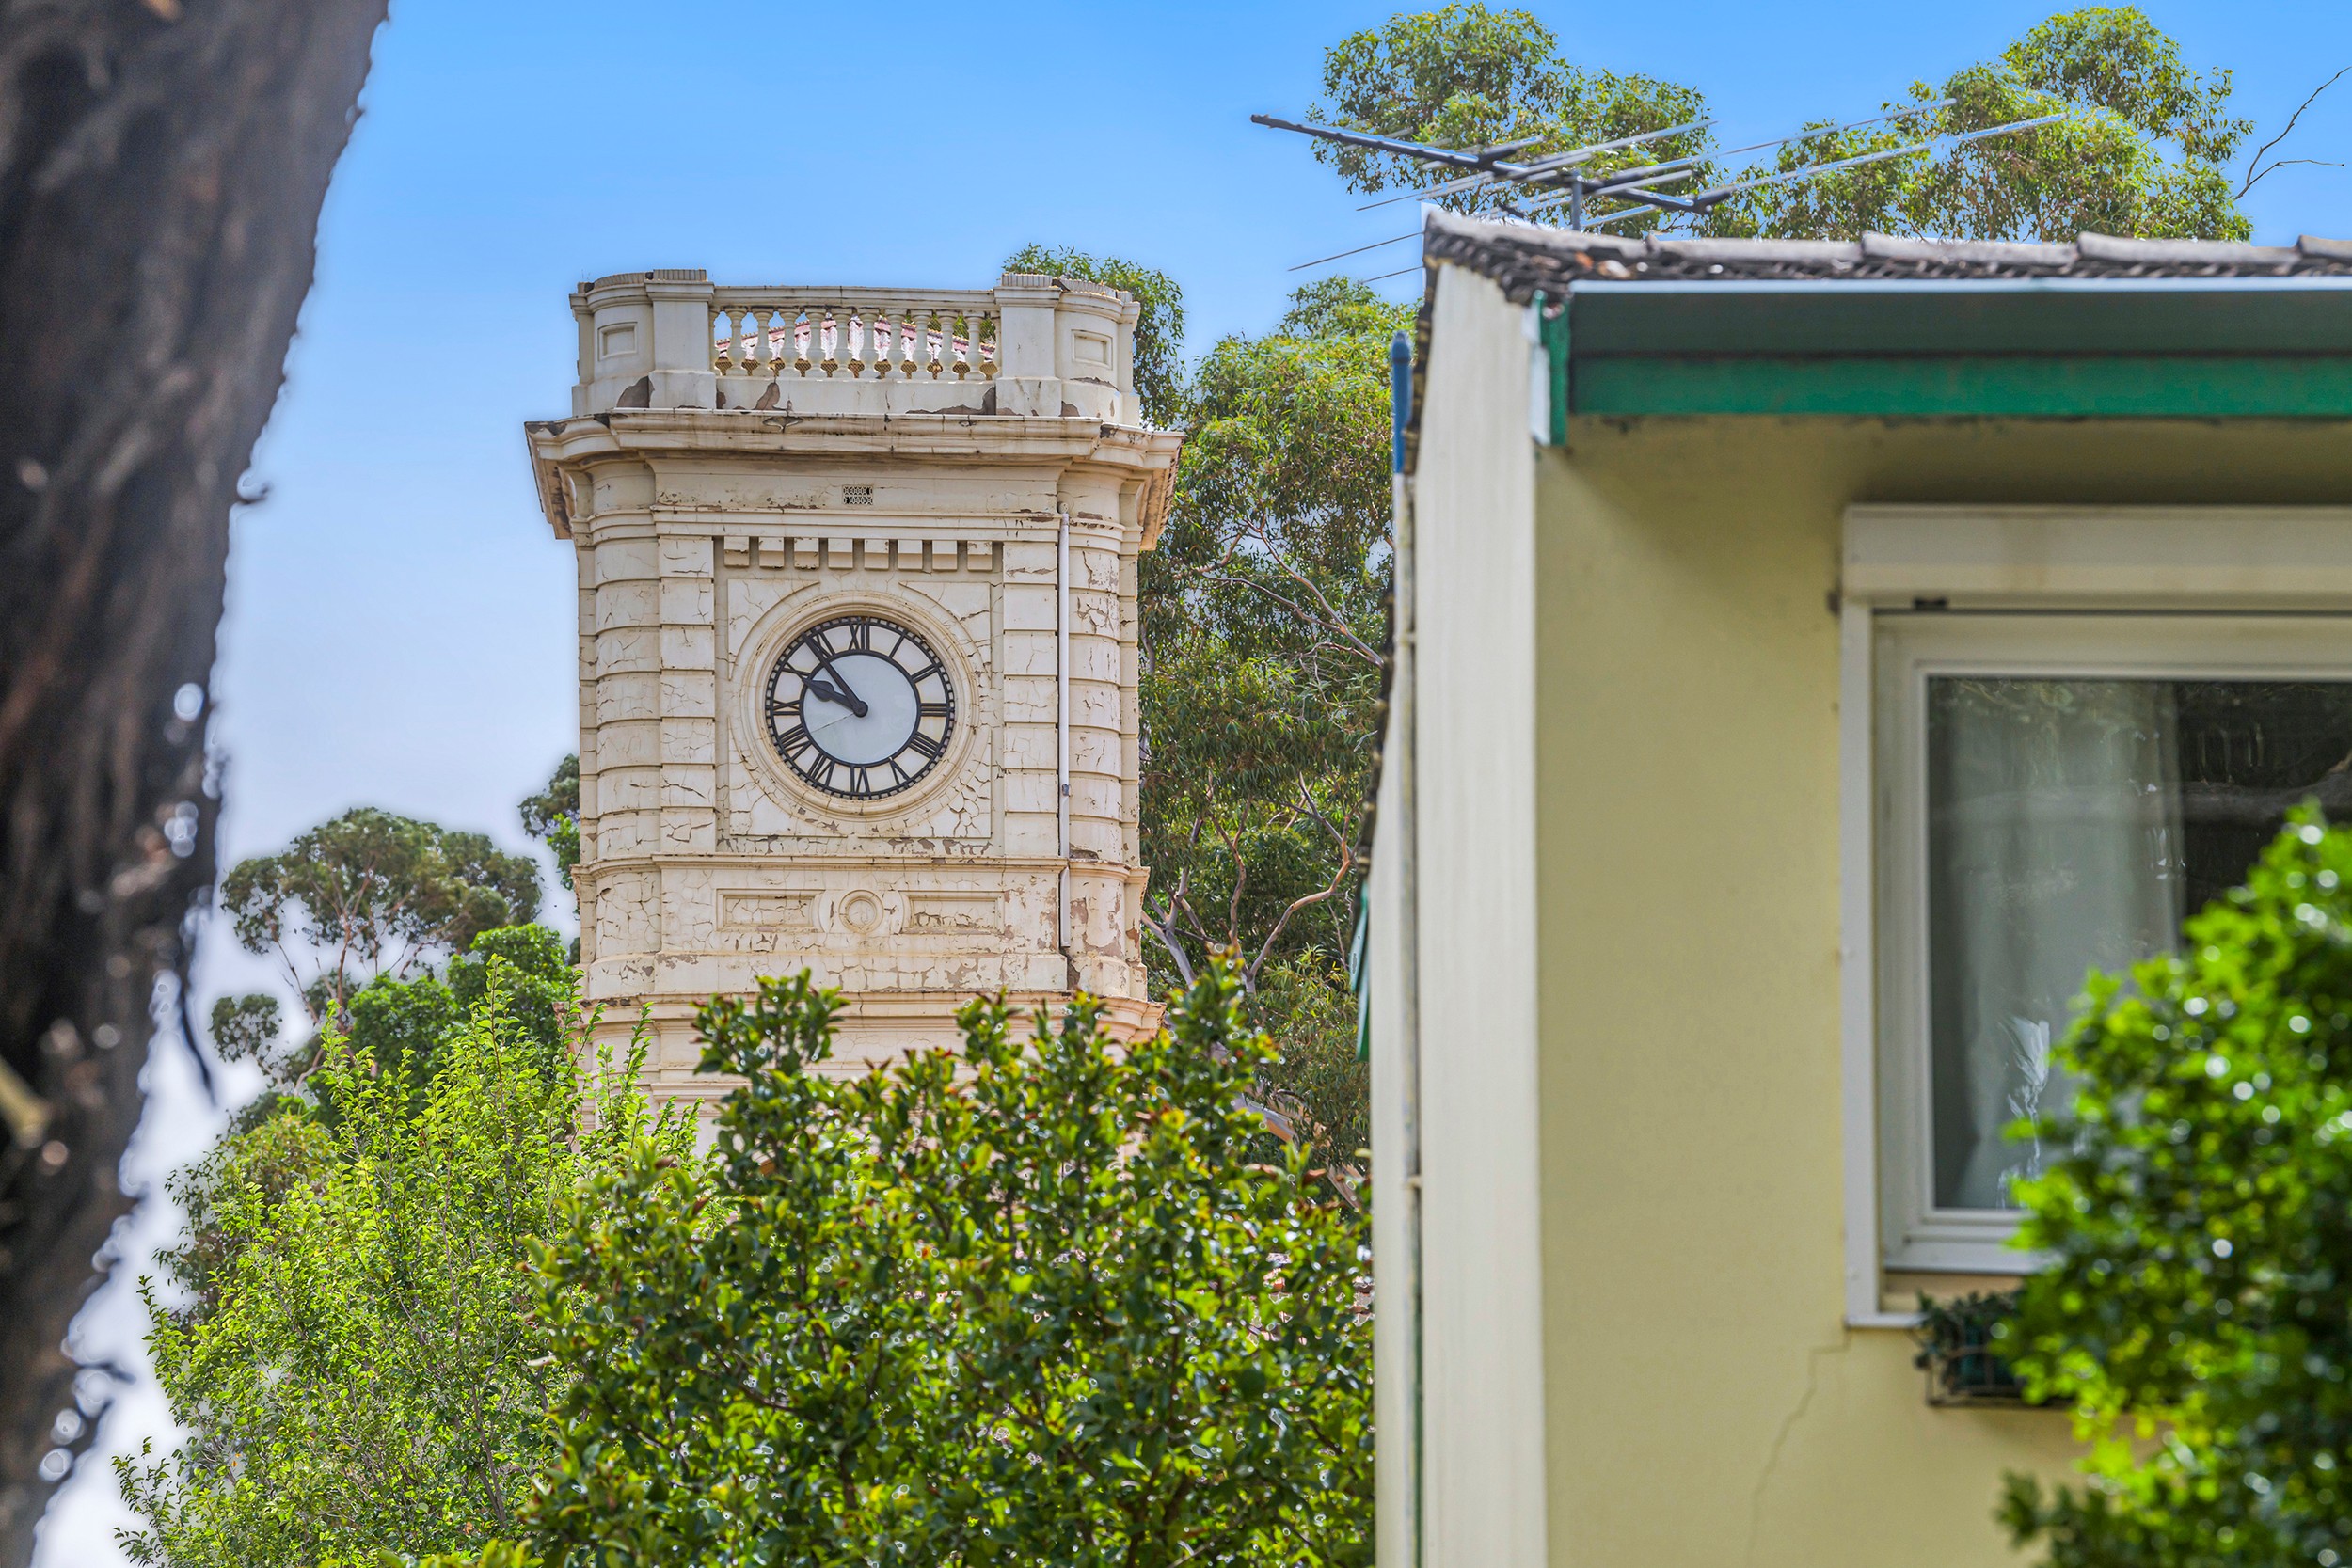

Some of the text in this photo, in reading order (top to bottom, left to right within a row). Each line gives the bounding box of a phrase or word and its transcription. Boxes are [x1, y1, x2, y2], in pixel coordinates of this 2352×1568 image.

[848, 624, 870, 651] XII
[888, 633, 905, 659] I
[910, 662, 940, 683] II
[771, 698, 802, 716] IX
[919, 702, 947, 717] III
[777, 723, 813, 762] VIII
[907, 730, 942, 760] IIII
[807, 752, 836, 788] VII
[850, 765, 871, 793] VI
[888, 757, 912, 786] V
